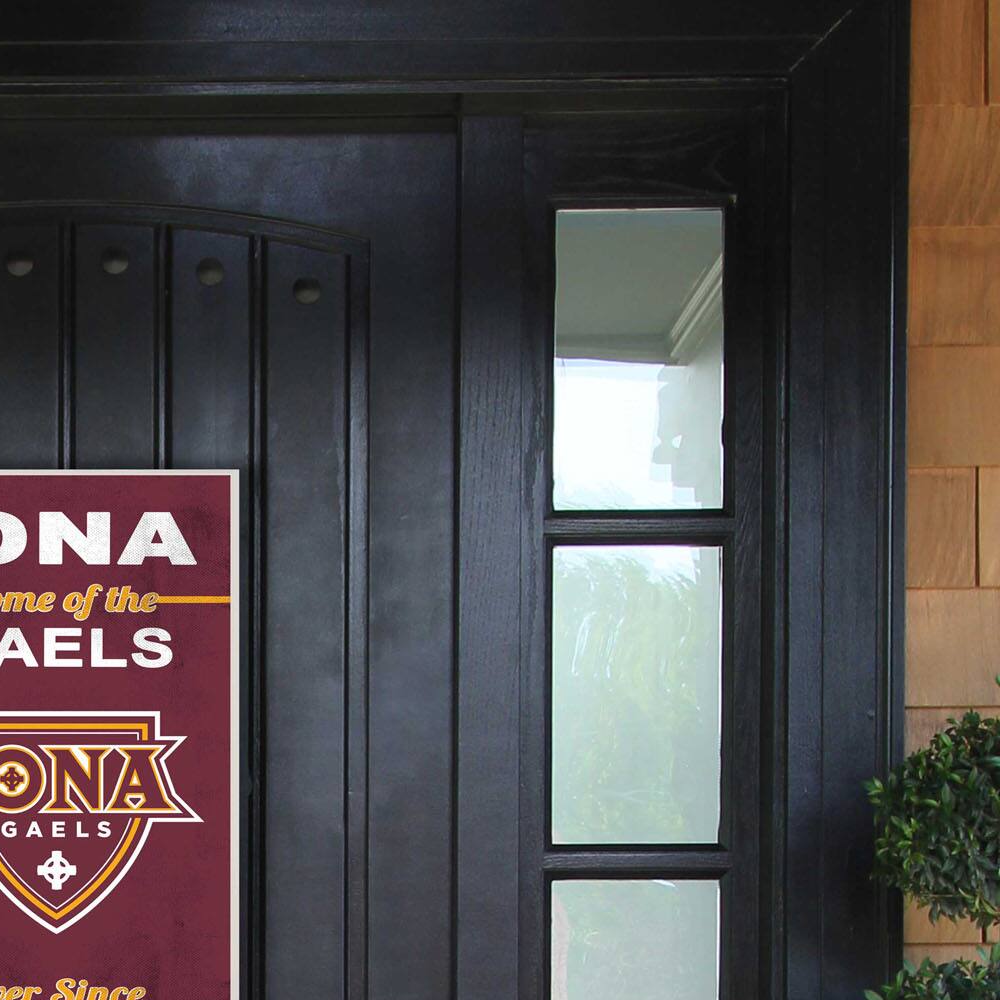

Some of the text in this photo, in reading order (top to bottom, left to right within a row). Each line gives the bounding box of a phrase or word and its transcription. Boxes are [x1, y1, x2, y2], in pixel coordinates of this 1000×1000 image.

[63, 584, 103, 621] of
[105, 585, 159, 613] the
[1, 821, 112, 838] GAELS
